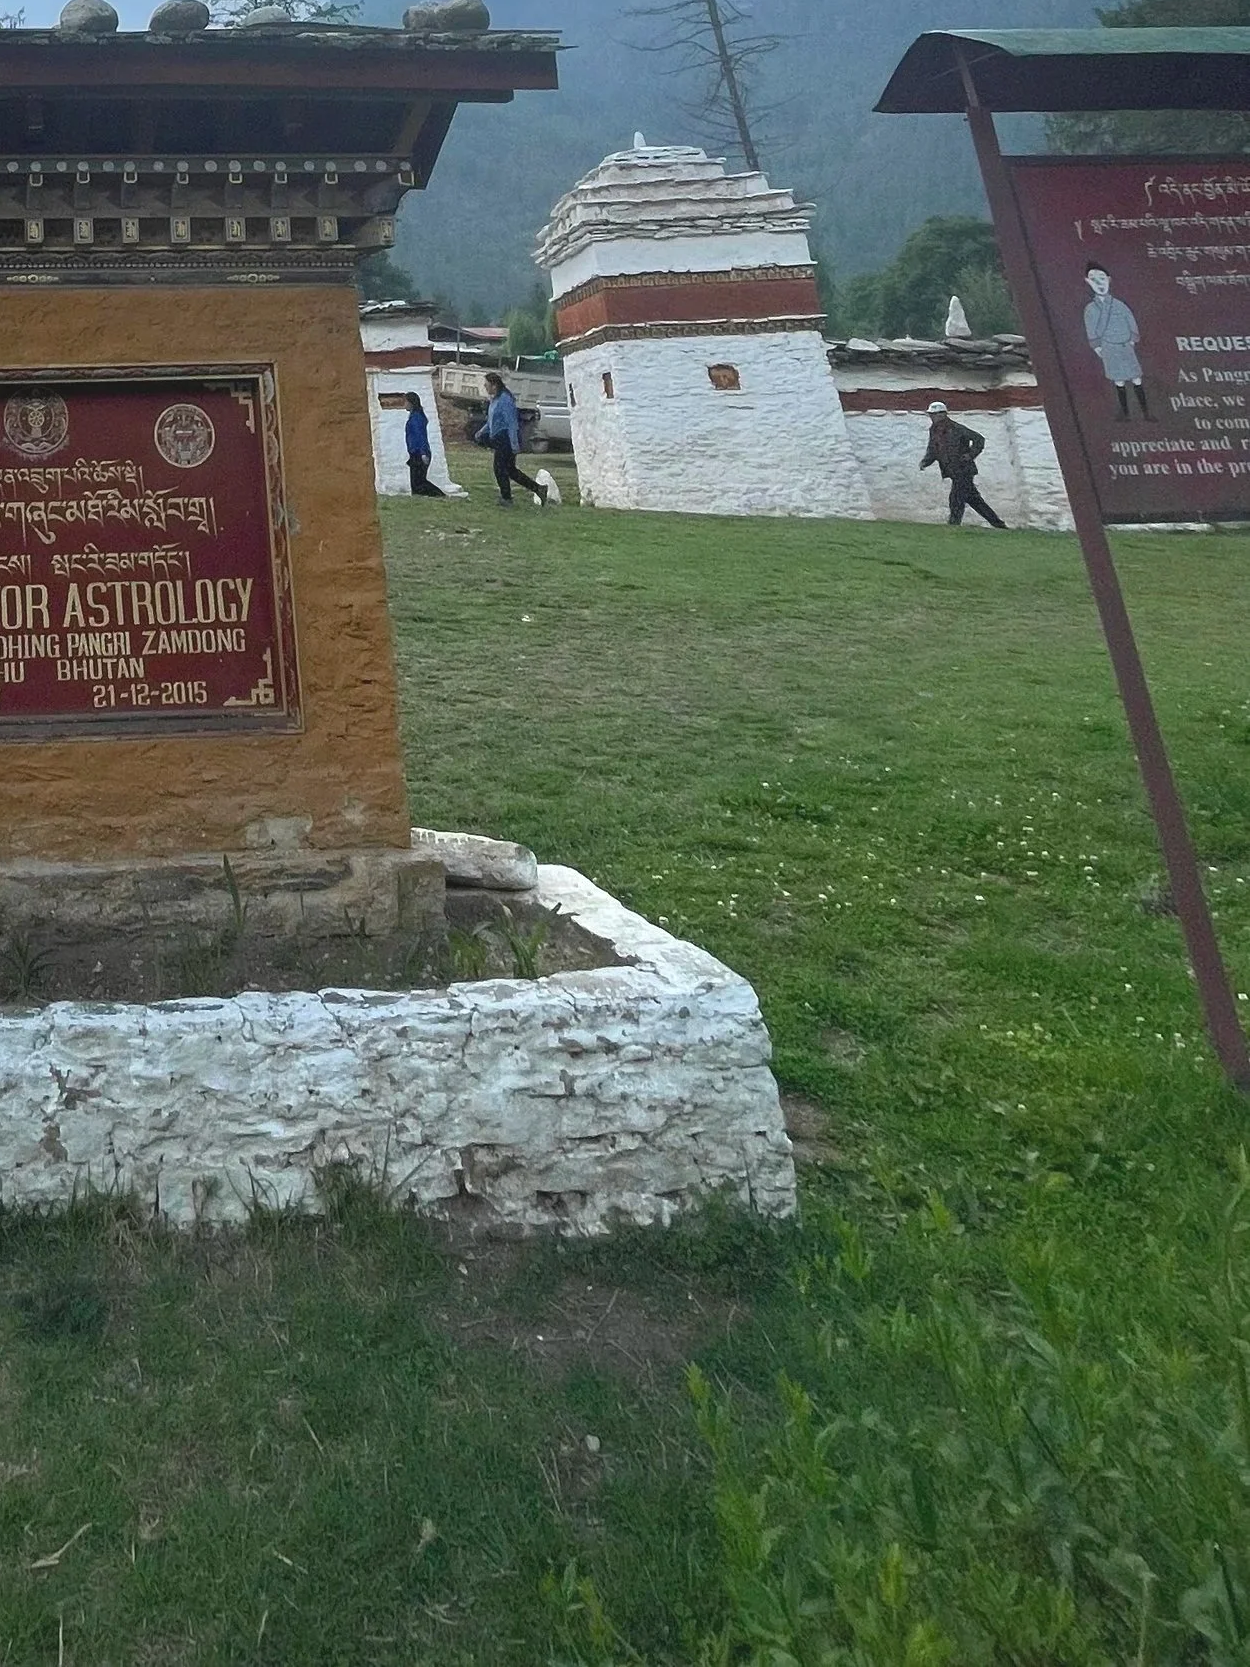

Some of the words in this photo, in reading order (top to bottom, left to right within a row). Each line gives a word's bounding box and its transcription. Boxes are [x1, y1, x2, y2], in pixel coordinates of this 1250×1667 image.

[1178, 368, 1198, 383] As
[1170, 392, 1218, 412] place,
[1222, 395, 1246, 407] we
[1194, 417, 1211, 429] to
[1111, 438, 1196, 457] appreciate
[1201, 436, 1232, 450] and
[1109, 463, 1140, 480] you
[1143, 462, 1170, 475] are
[1174, 458, 1193, 475] in
[1197, 457, 1224, 474] the
[63, 577, 254, 628] ASTROLOGY
[67, 631, 131, 657] PANGRI
[142, 628, 246, 655] ZAMDONG
[57, 657, 144, 681] BHUTAN
[92, 681, 208, 708] 21-12-2015
